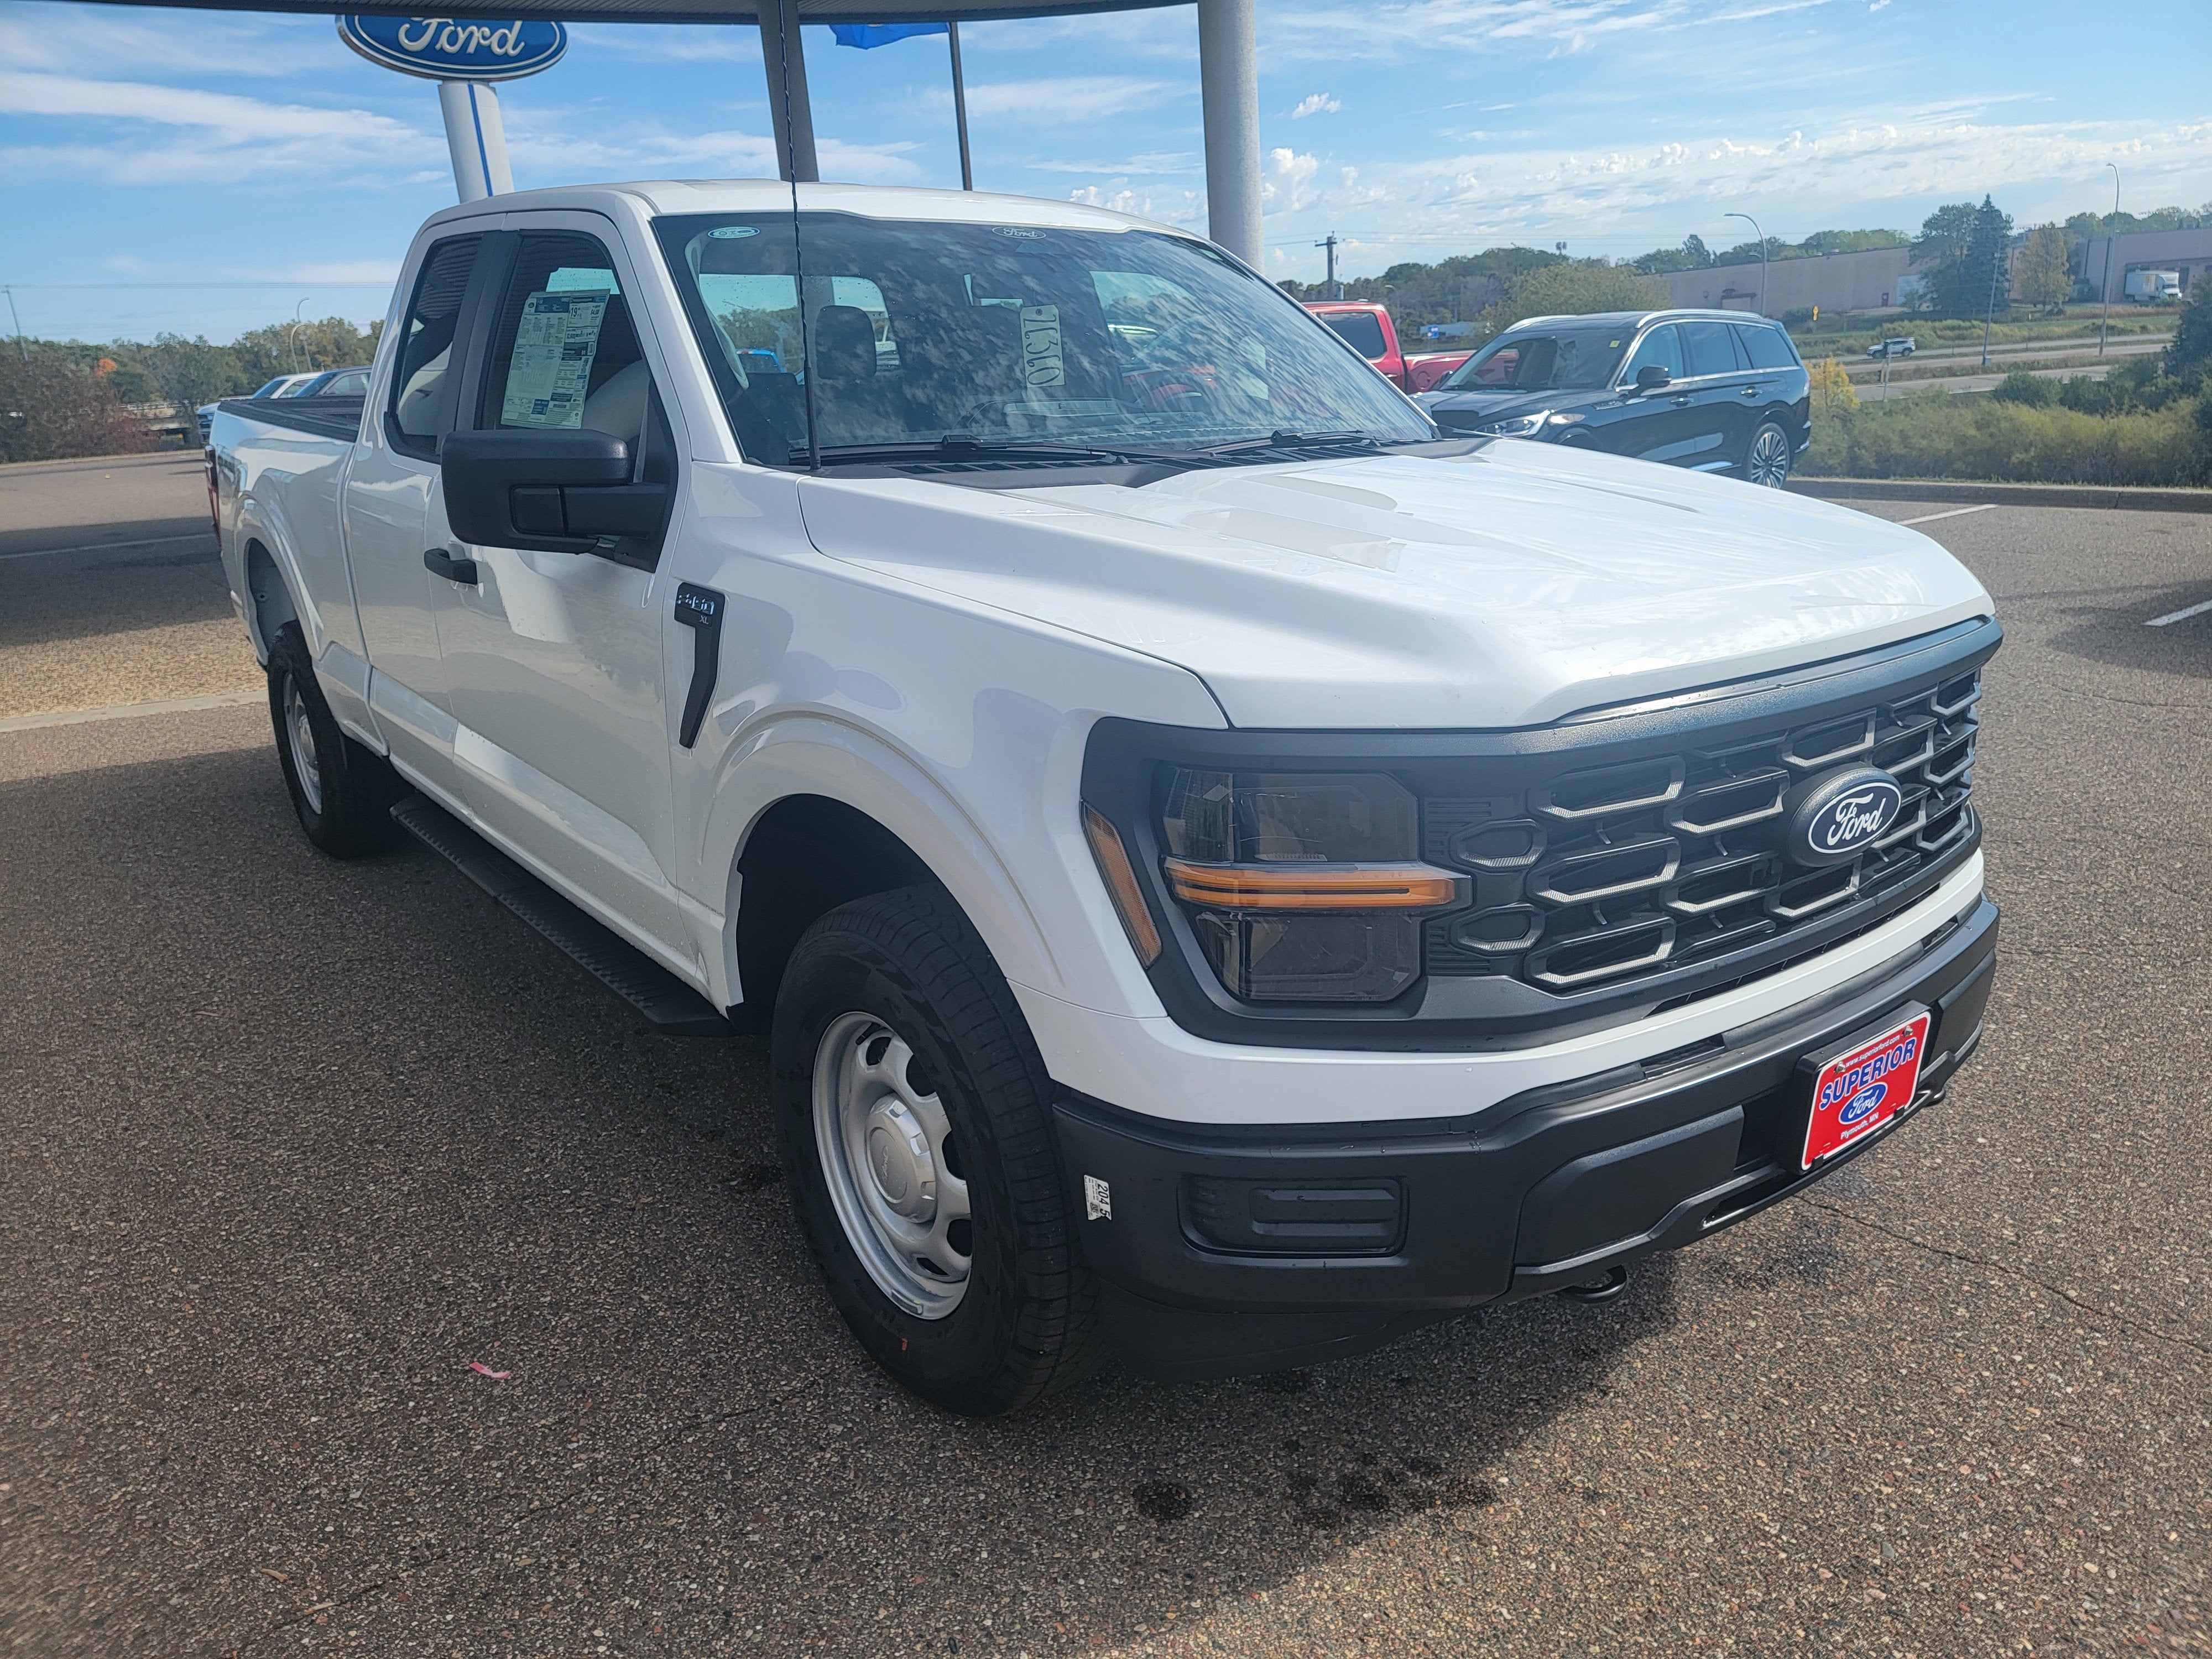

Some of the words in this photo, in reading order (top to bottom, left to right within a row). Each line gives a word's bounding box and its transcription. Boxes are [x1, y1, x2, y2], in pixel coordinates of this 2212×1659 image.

[398, 17, 525, 56] Ford
[1003, 227, 1038, 237] Ford
[699, 615, 709, 625] XL
[1827, 792, 1886, 846] Ford
[1819, 1037, 1917, 1110] SUPERIOR
[1848, 1088, 1880, 1119] Ford
[1869, 1112, 1879, 1123] MN
